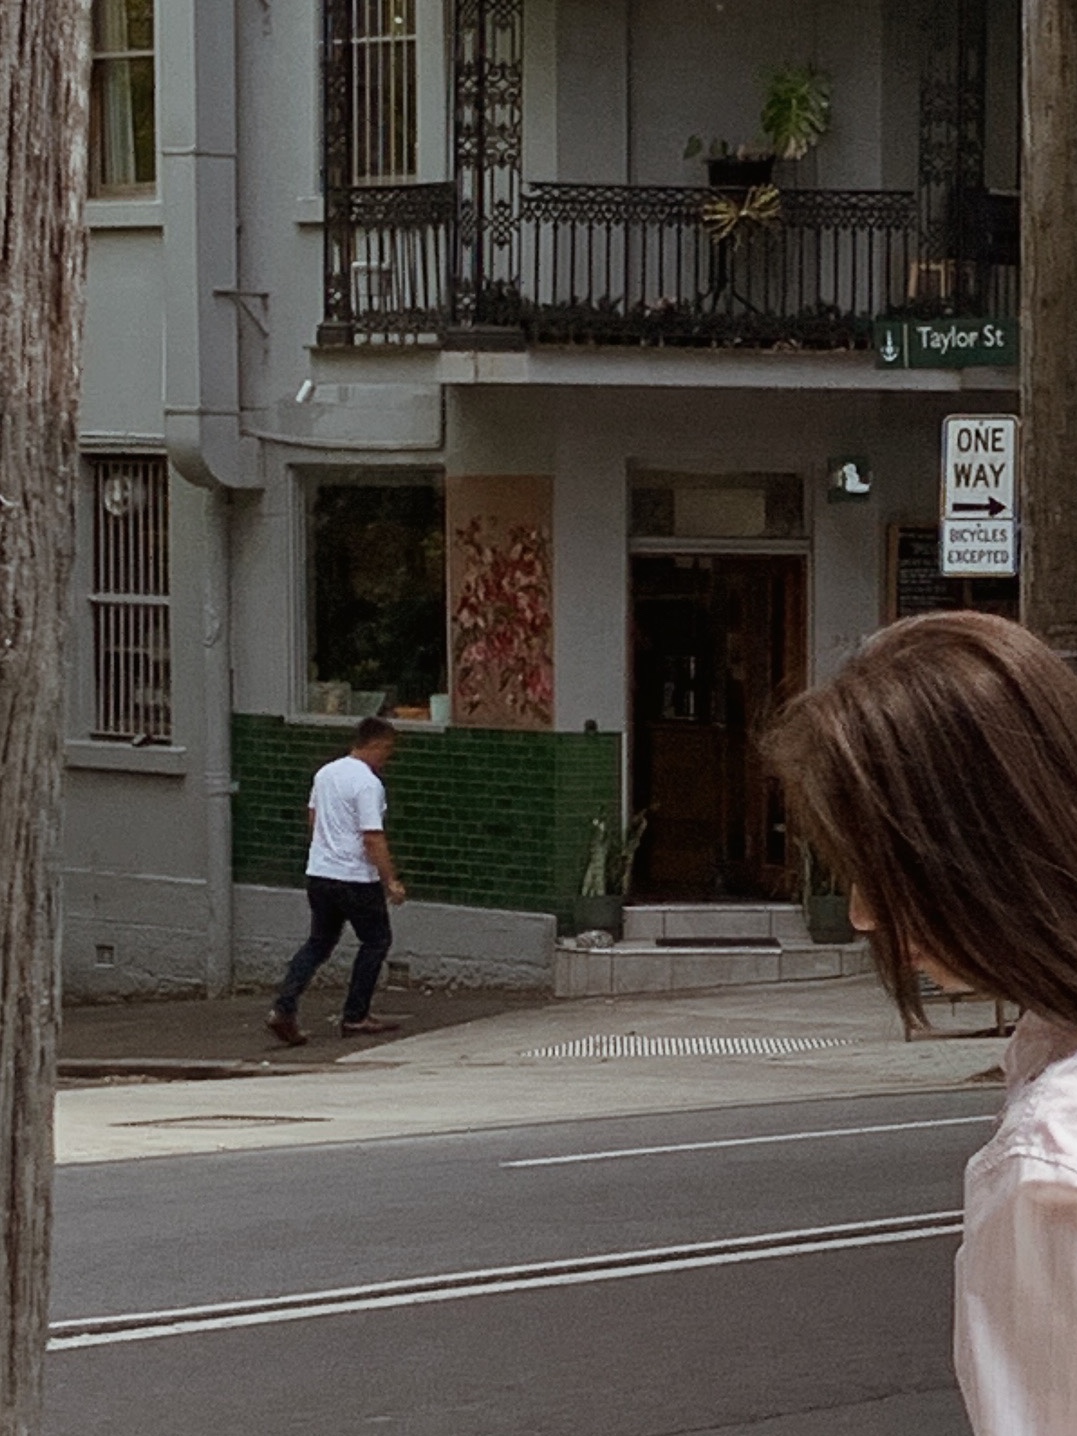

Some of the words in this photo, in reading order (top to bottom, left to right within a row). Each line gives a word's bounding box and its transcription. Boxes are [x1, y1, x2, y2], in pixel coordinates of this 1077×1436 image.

[915, 325, 979, 355] Taylor
[983, 324, 1005, 347] St
[957, 427, 1005, 453] ONE
[953, 463, 1005, 488] WAY
[949, 528, 1008, 543] BICYCLES
[947, 549, 1009, 564] EXCEPTED
